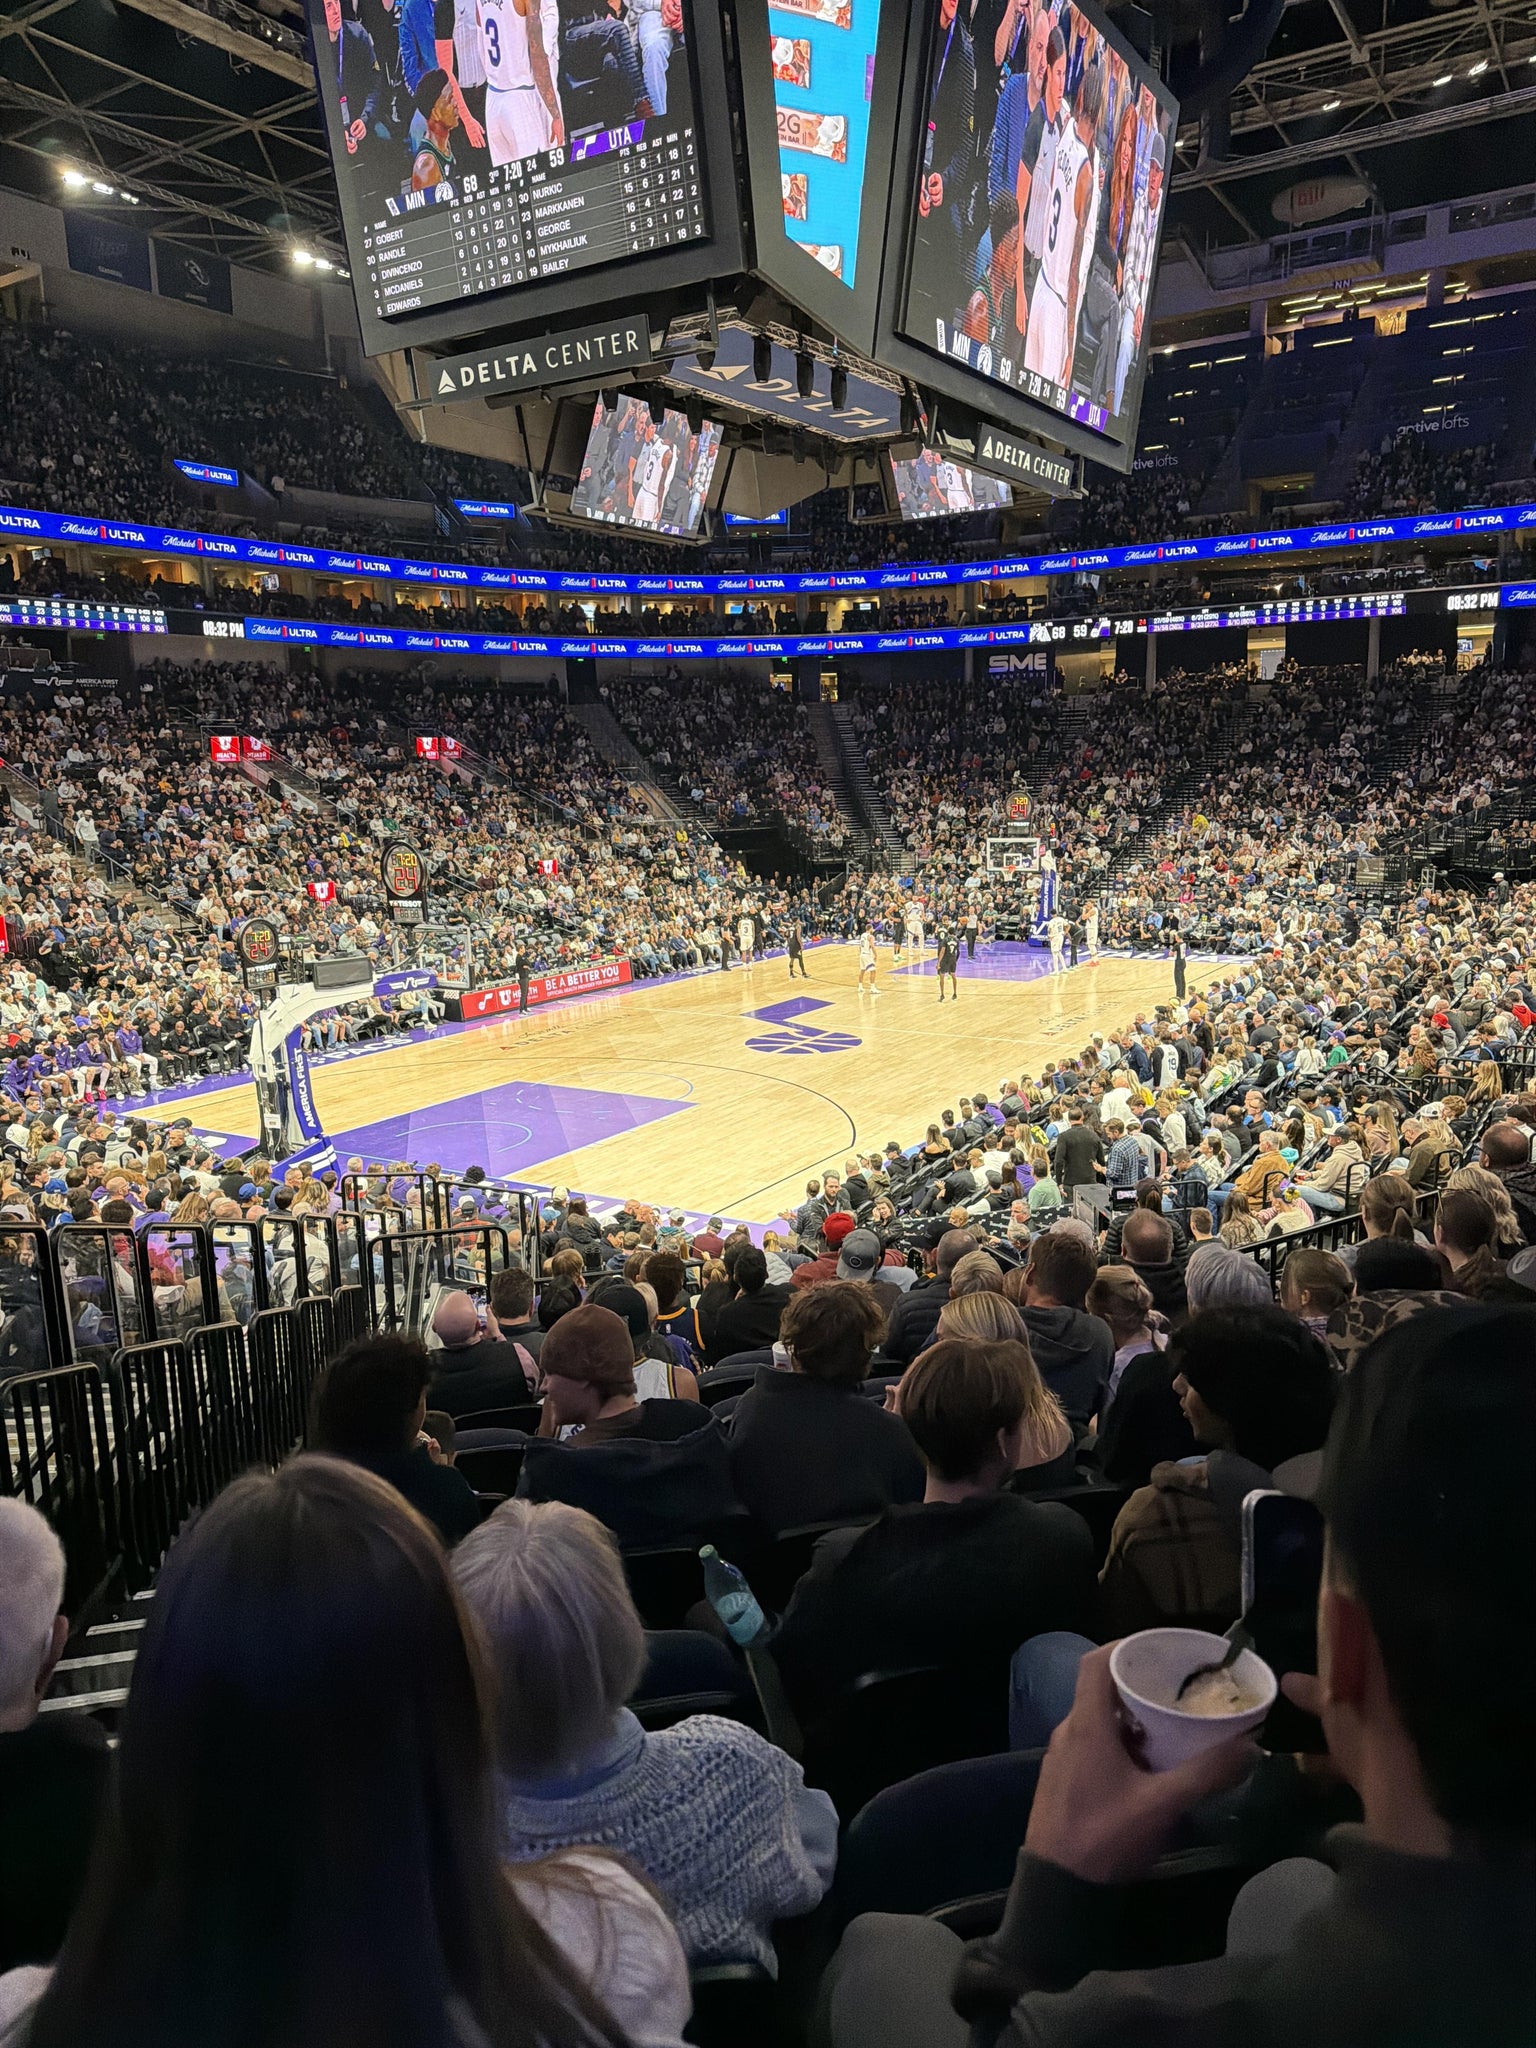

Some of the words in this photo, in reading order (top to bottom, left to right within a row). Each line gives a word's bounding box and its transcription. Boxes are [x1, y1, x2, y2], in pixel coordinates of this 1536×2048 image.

[485, 18, 502, 67] 3
[777, 112, 800, 134] 2G
[406, 190, 425, 210] MIN
[464, 175, 477, 193] 68
[504, 161, 522, 181] 7:20
[527, 159, 536, 171] 24
[550, 148, 564, 167] 59
[609, 126, 632, 150] UTA
[519, 193, 528, 203] 30
[533, 183, 562, 200] NURKIC
[624, 163, 629, 173] 5
[641, 158, 646, 168] 8
[657, 154, 660, 163] 1
[669, 149, 678, 160] 18
[687, 145, 692, 155] 2
[522, 211, 531, 222] 23
[535, 196, 584, 218] MARKKANEN
[624, 182, 633, 193] 15
[643, 178, 648, 188] 6
[658, 174, 663, 184] 2
[672, 169, 680, 180] 21
[690, 165, 694, 174] 1
[364, 239, 371, 248] 27
[376, 229, 403, 244] GOBERT
[453, 213, 460, 222] 12
[468, 210, 473, 218] 9
[481, 206, 485, 215] 0
[493, 202, 500, 211] 19
[508, 198, 512, 207] 3
[526, 230, 531, 240] 3
[538, 220, 570, 237] GEORGE
[626, 202, 635, 212] 16
[645, 198, 650, 207] 4
[660, 194, 666, 203] 4
[673, 189, 683, 200] 22
[691, 185, 696, 195] 2
[1049, 188, 1061, 253] 3
[367, 256, 375, 265] 30
[379, 247, 406, 262] RANDLE
[455, 231, 463, 240] 13
[471, 228, 475, 236] 6
[483, 224, 488, 232] 5
[495, 219, 504, 230] 22
[511, 216, 514, 225] 1
[527, 248, 535, 258] 10
[540, 235, 587, 255] MYKHAILIUK
[631, 222, 636, 232] 5
[647, 218, 652, 227] 3
[663, 214, 667, 223] 1
[676, 209, 684, 219] 17
[694, 205, 698, 214] 1
[372, 273, 376, 281] 0
[382, 261, 422, 279] DIVINCENZO
[459, 249, 464, 258] 6
[473, 246, 478, 254] 0
[486, 242, 490, 250] 1
[497, 238, 506, 248] 20
[513, 235, 518, 243] 0
[530, 267, 537, 276] 19
[543, 258, 568, 273] BAILEY
[633, 241, 638, 250] 4
[649, 237, 654, 246] 7
[665, 233, 669, 242] 1
[677, 228, 686, 239] 18
[695, 225, 701, 234] 3
[374, 290, 379, 298] 3
[384, 279, 423, 296] MCDANIELS
[462, 267, 466, 276] 2
[476, 263, 480, 272] 4
[488, 260, 493, 269] 3
[500, 256, 508, 265] 19
[515, 253, 520, 262] 3
[377, 307, 382, 315] 5
[387, 297, 421, 313] EDWARDS
[463, 284, 470, 293] 21
[478, 281, 483, 289] 4
[491, 278, 495, 286] 3
[502, 274, 511, 283] 22
[518, 271, 522, 279] 0
[460, 353, 537, 386] DELTA
[546, 331, 638, 368] CENTER
[953, 330, 970, 360] MIN
[1000, 358, 1011, 381] 68
[1043, 383, 1050, 398] 24
[1056, 388, 1066, 409] 59
[1089, 404, 1100, 426] UTA
[743, 376, 892, 432] DELTA
[1442, 415, 1469, 430] lofts
[995, 442, 1030, 470] DELTA
[1034, 457, 1069, 485] CENTER
[1156, 454, 1178, 467] lofts
[210, 472, 232, 480] ULTRA
[0, 515, 40, 528] ULTRA
[61, 522, 98, 536] Michelob
[109, 529, 144, 542] ULTRA
[1414, 520, 1452, 532] Michelob
[1464, 516, 1503, 526] ULTRA
[163, 535, 195, 548] Michelob
[205, 542, 236, 553] ULTRA
[1215, 541, 1248, 552] Michelob
[1258, 537, 1292, 547] ULTRA
[1311, 531, 1347, 542] Michelob
[1358, 527, 1394, 537] ULTRA
[248, 546, 278, 558] Michelob
[286, 552, 314, 562] ULTRA
[1125, 550, 1156, 561] Michelob
[1166, 546, 1197, 556] ULTRA
[329, 557, 355, 568] Michelob
[363, 562, 390, 572] ULTRA
[1448, 594, 1477, 610] 08:32
[1480, 593, 1498, 607] PM
[203, 621, 228, 636] 08:32
[230, 623, 244, 637] PM
[252, 625, 280, 635] Michelob
[289, 629, 317, 638] ULTRA
[331, 631, 358, 640] Michelob
[366, 635, 392, 643] ULTRA
[1052, 626, 1065, 639] 68
[1074, 625, 1086, 637] 59
[1115, 620, 1133, 634] 7:20
[989, 653, 1046, 672] SME
[1010, 804, 1026, 819] 24
[397, 854, 417, 866] 7:20
[394, 867, 418, 890] 24
[250, 943, 268, 958] 24
[545, 979, 557, 990] BE
[560, 978, 566, 987] A
[568, 970, 599, 986] BETTER
[601, 965, 619, 977] YOU
[294, 1048, 304, 1079] FIRST
[1169, 1058, 1176, 1070] 19
[299, 1080, 316, 1128] AMERICA
